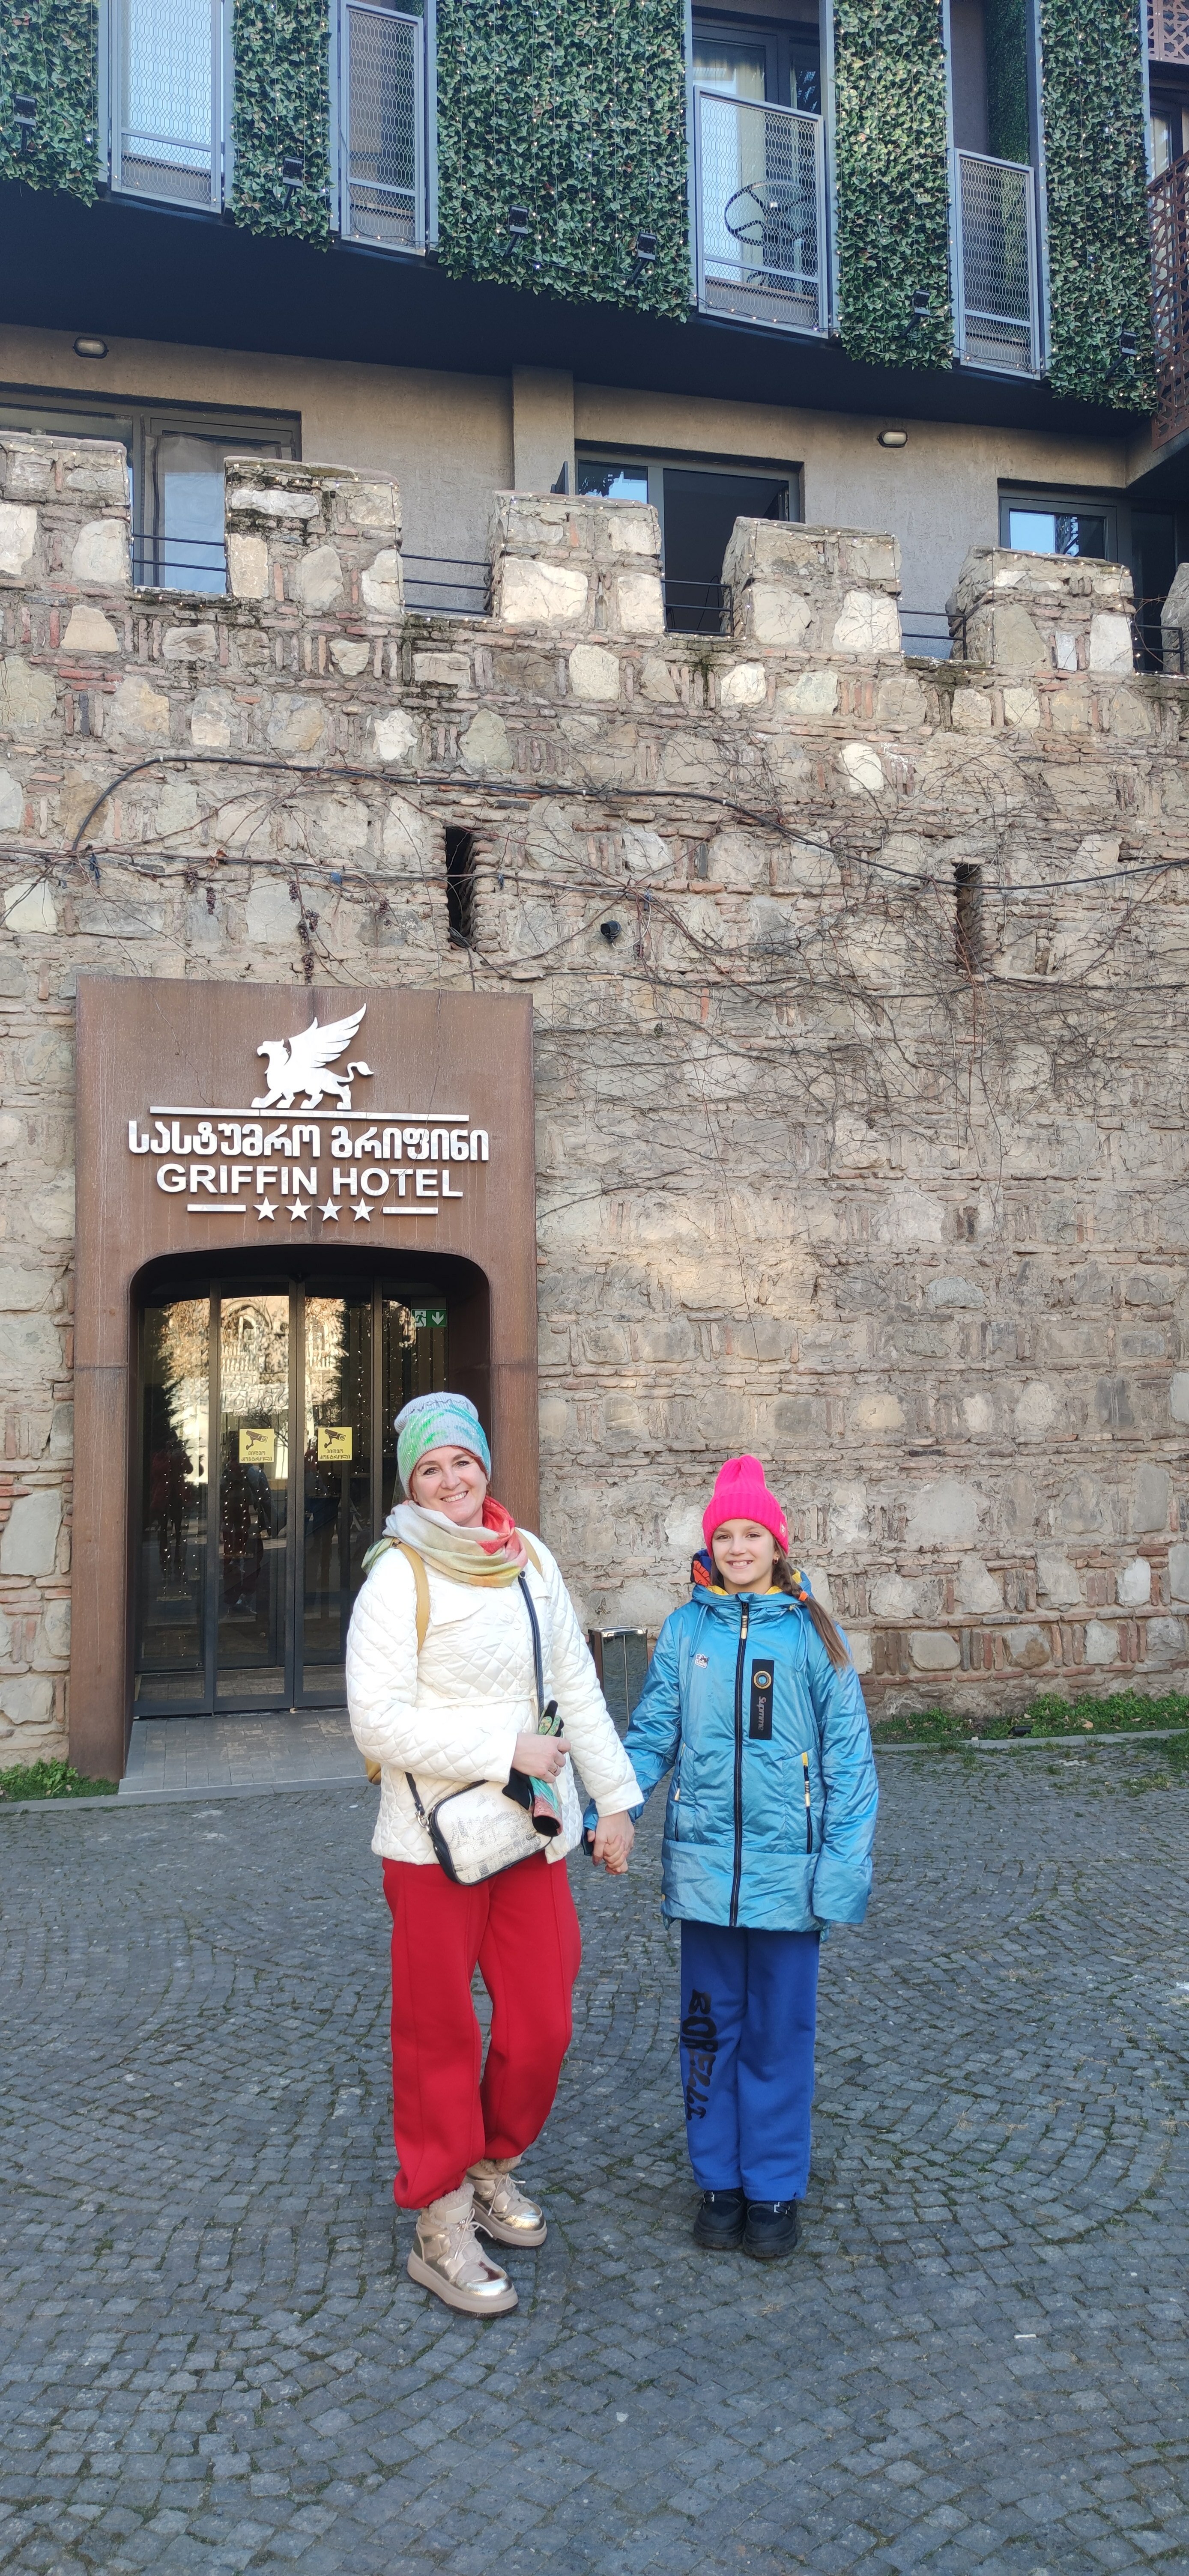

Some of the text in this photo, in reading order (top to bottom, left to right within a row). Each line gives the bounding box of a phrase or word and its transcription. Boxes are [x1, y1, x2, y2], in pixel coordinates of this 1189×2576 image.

[128, 1120, 489, 1161] სასტუმრო გრიფინი
[156, 1163, 463, 1197] GRIFFIN HOTEL
[681, 1989, 718, 2121] BORELLI
